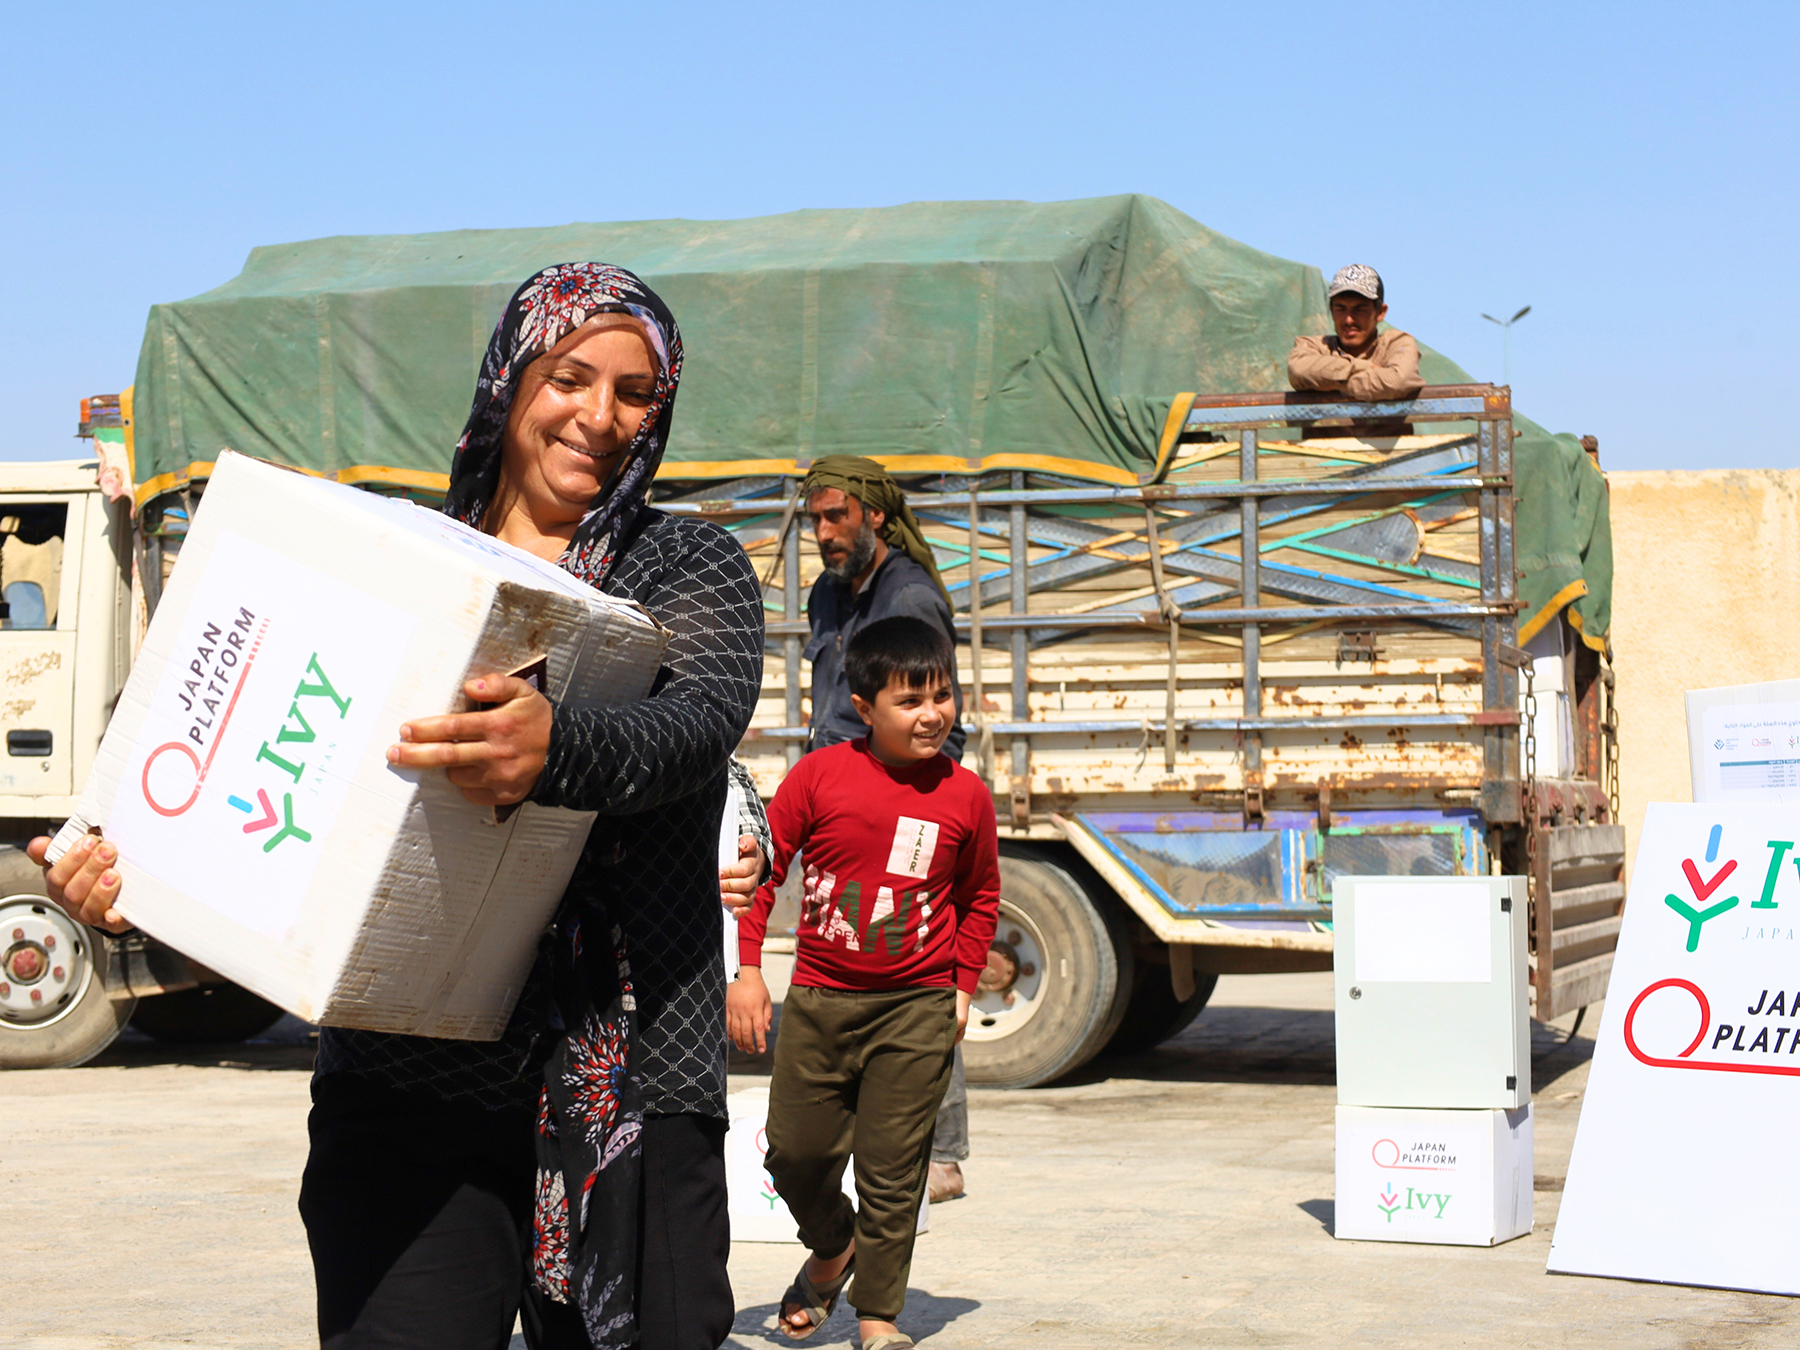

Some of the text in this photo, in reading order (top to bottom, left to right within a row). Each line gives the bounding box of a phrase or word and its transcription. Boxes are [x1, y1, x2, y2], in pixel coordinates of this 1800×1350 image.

[177, 621, 223, 712] JAPAN
[188, 606, 256, 746] PLATFORM
[256, 651, 353, 785] Ivy
[309, 741, 338, 797] JAPAN
[909, 824, 925, 873] ZAER
[1402, 1153, 1457, 1165] PLATFORM
[1411, 1142, 1446, 1152] JAPAN
[1405, 1187, 1453, 1219] Ivy
